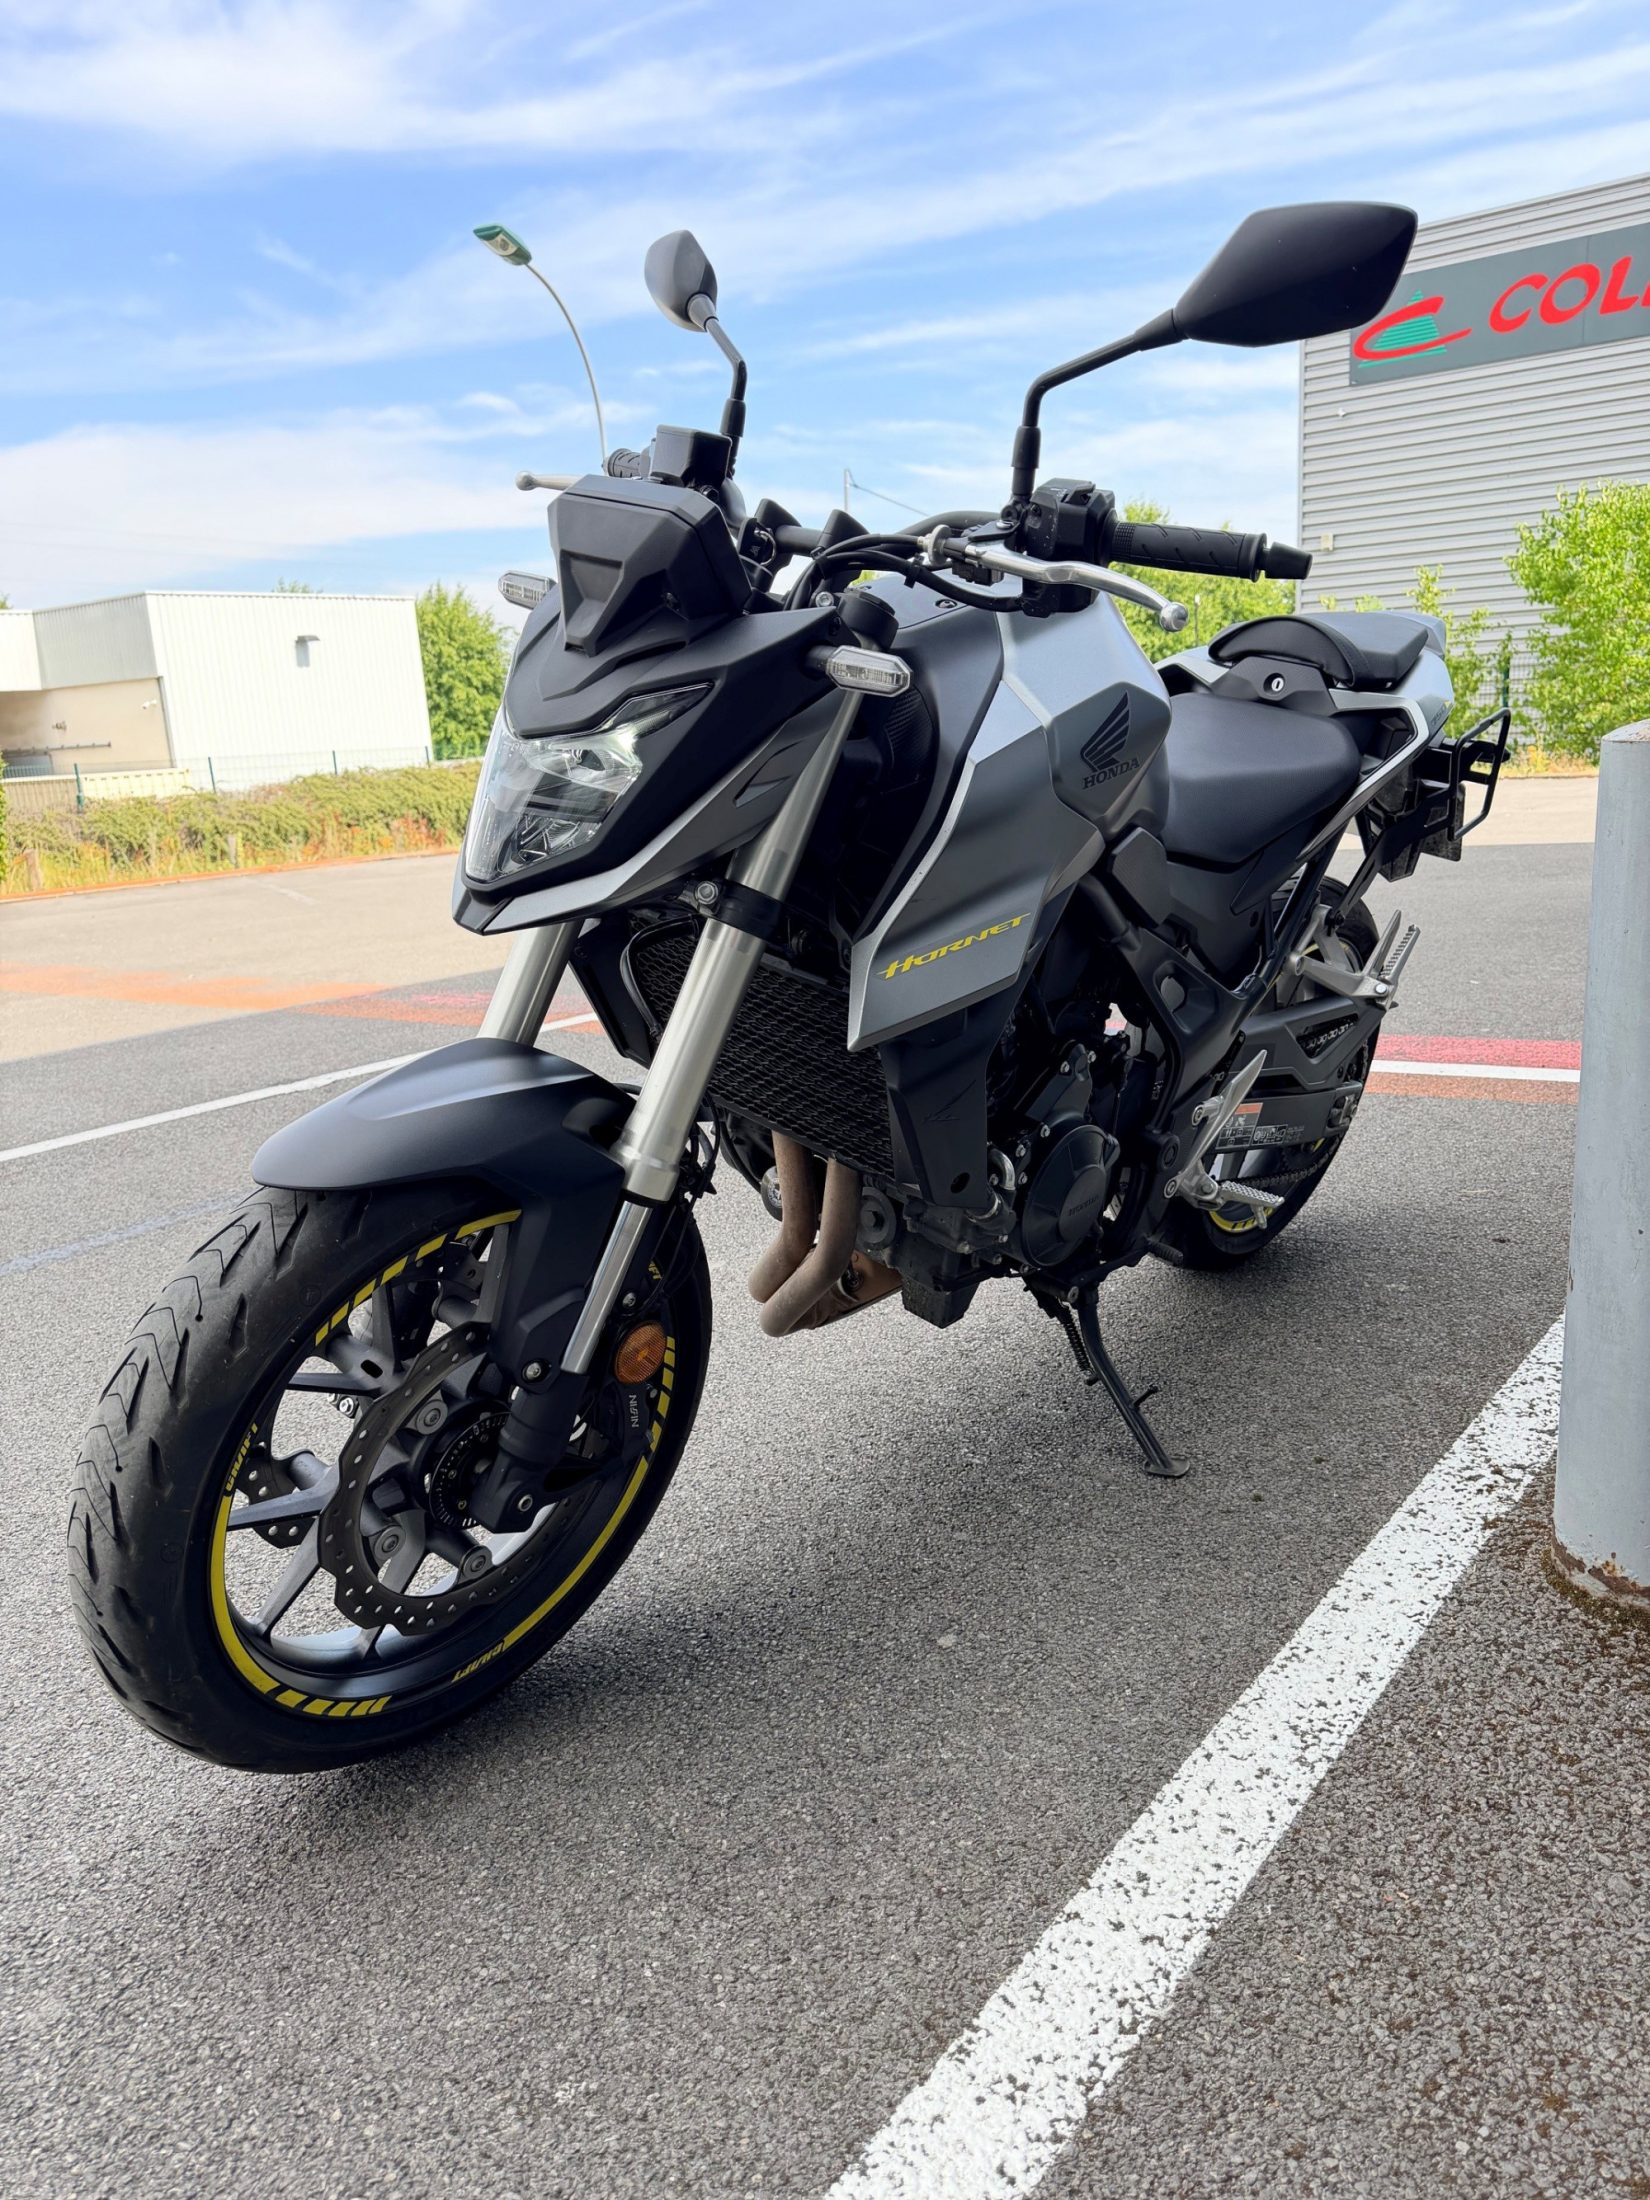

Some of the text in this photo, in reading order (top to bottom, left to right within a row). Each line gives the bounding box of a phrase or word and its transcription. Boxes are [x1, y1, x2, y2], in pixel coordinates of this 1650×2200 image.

[1489, 256, 1650, 334] COL
[1082, 757, 1141, 790] HONDA
[877, 912, 1031, 980] HORNET
